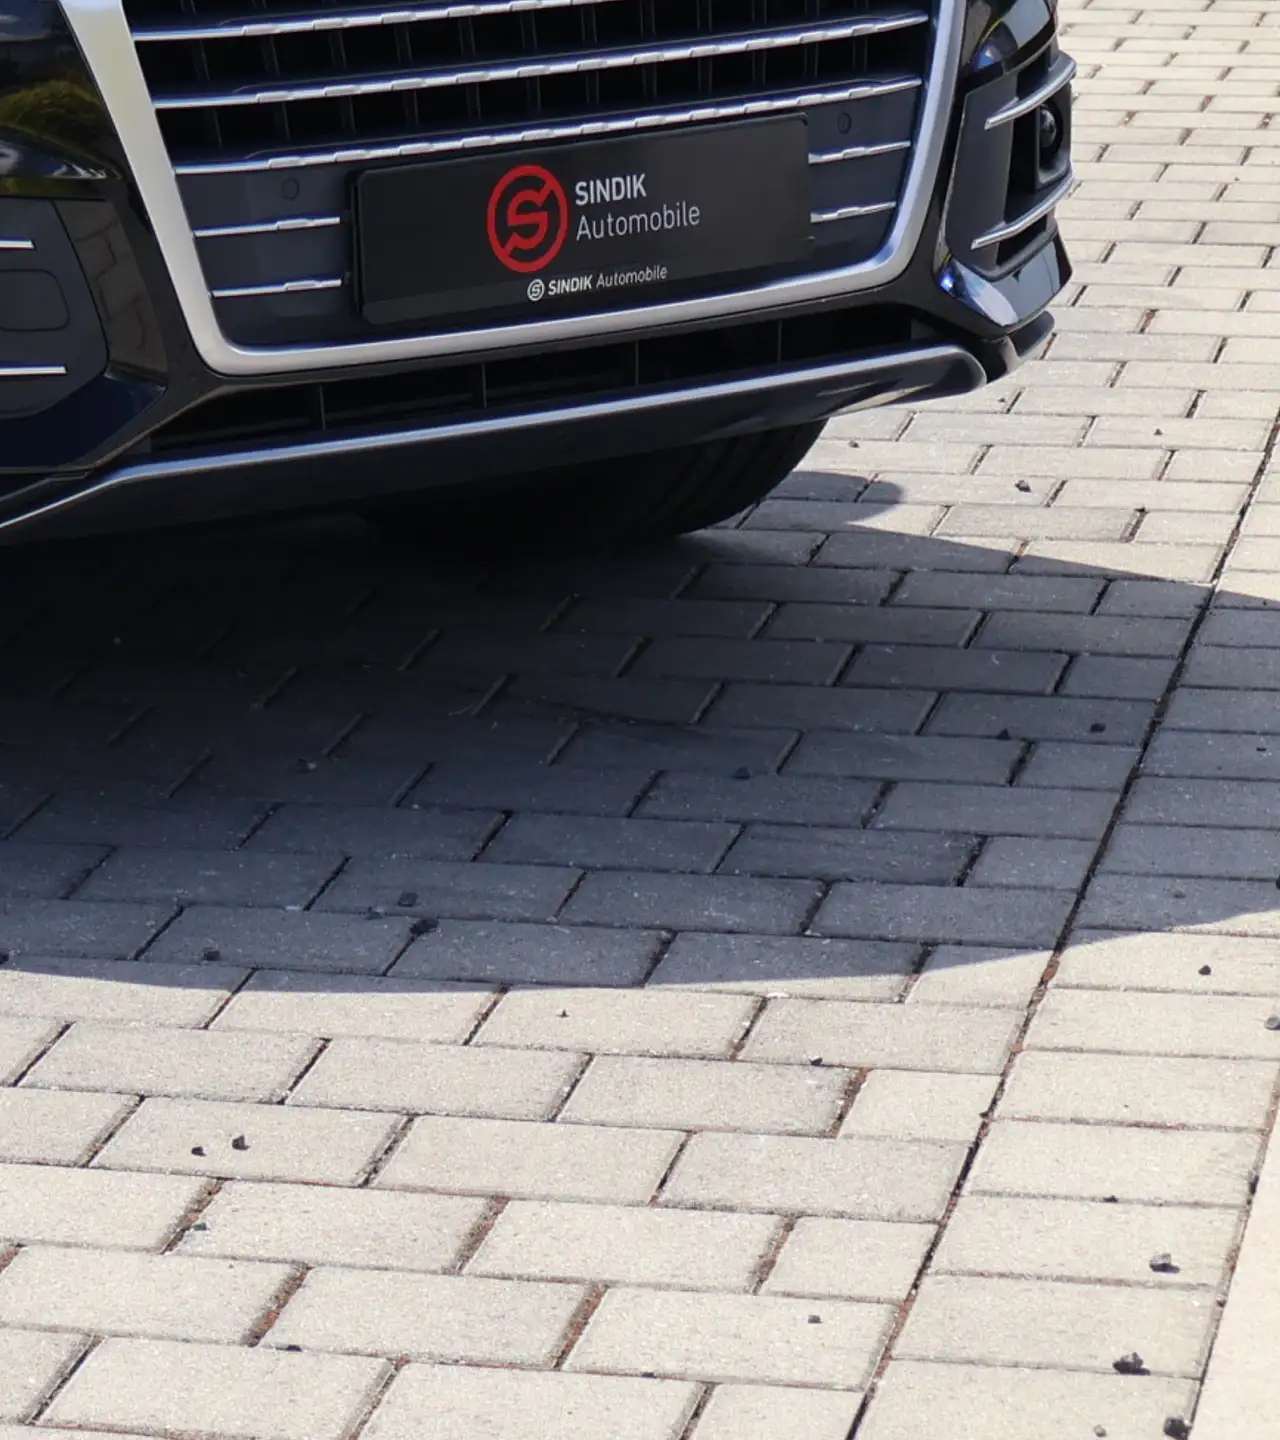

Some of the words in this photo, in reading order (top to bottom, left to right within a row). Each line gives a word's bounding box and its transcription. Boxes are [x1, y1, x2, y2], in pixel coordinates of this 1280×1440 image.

[575, 174, 647, 206] SINDIK
[576, 201, 700, 241] Automobile
[548, 275, 592, 296] SINDIK
[596, 266, 667, 289] Automobile
